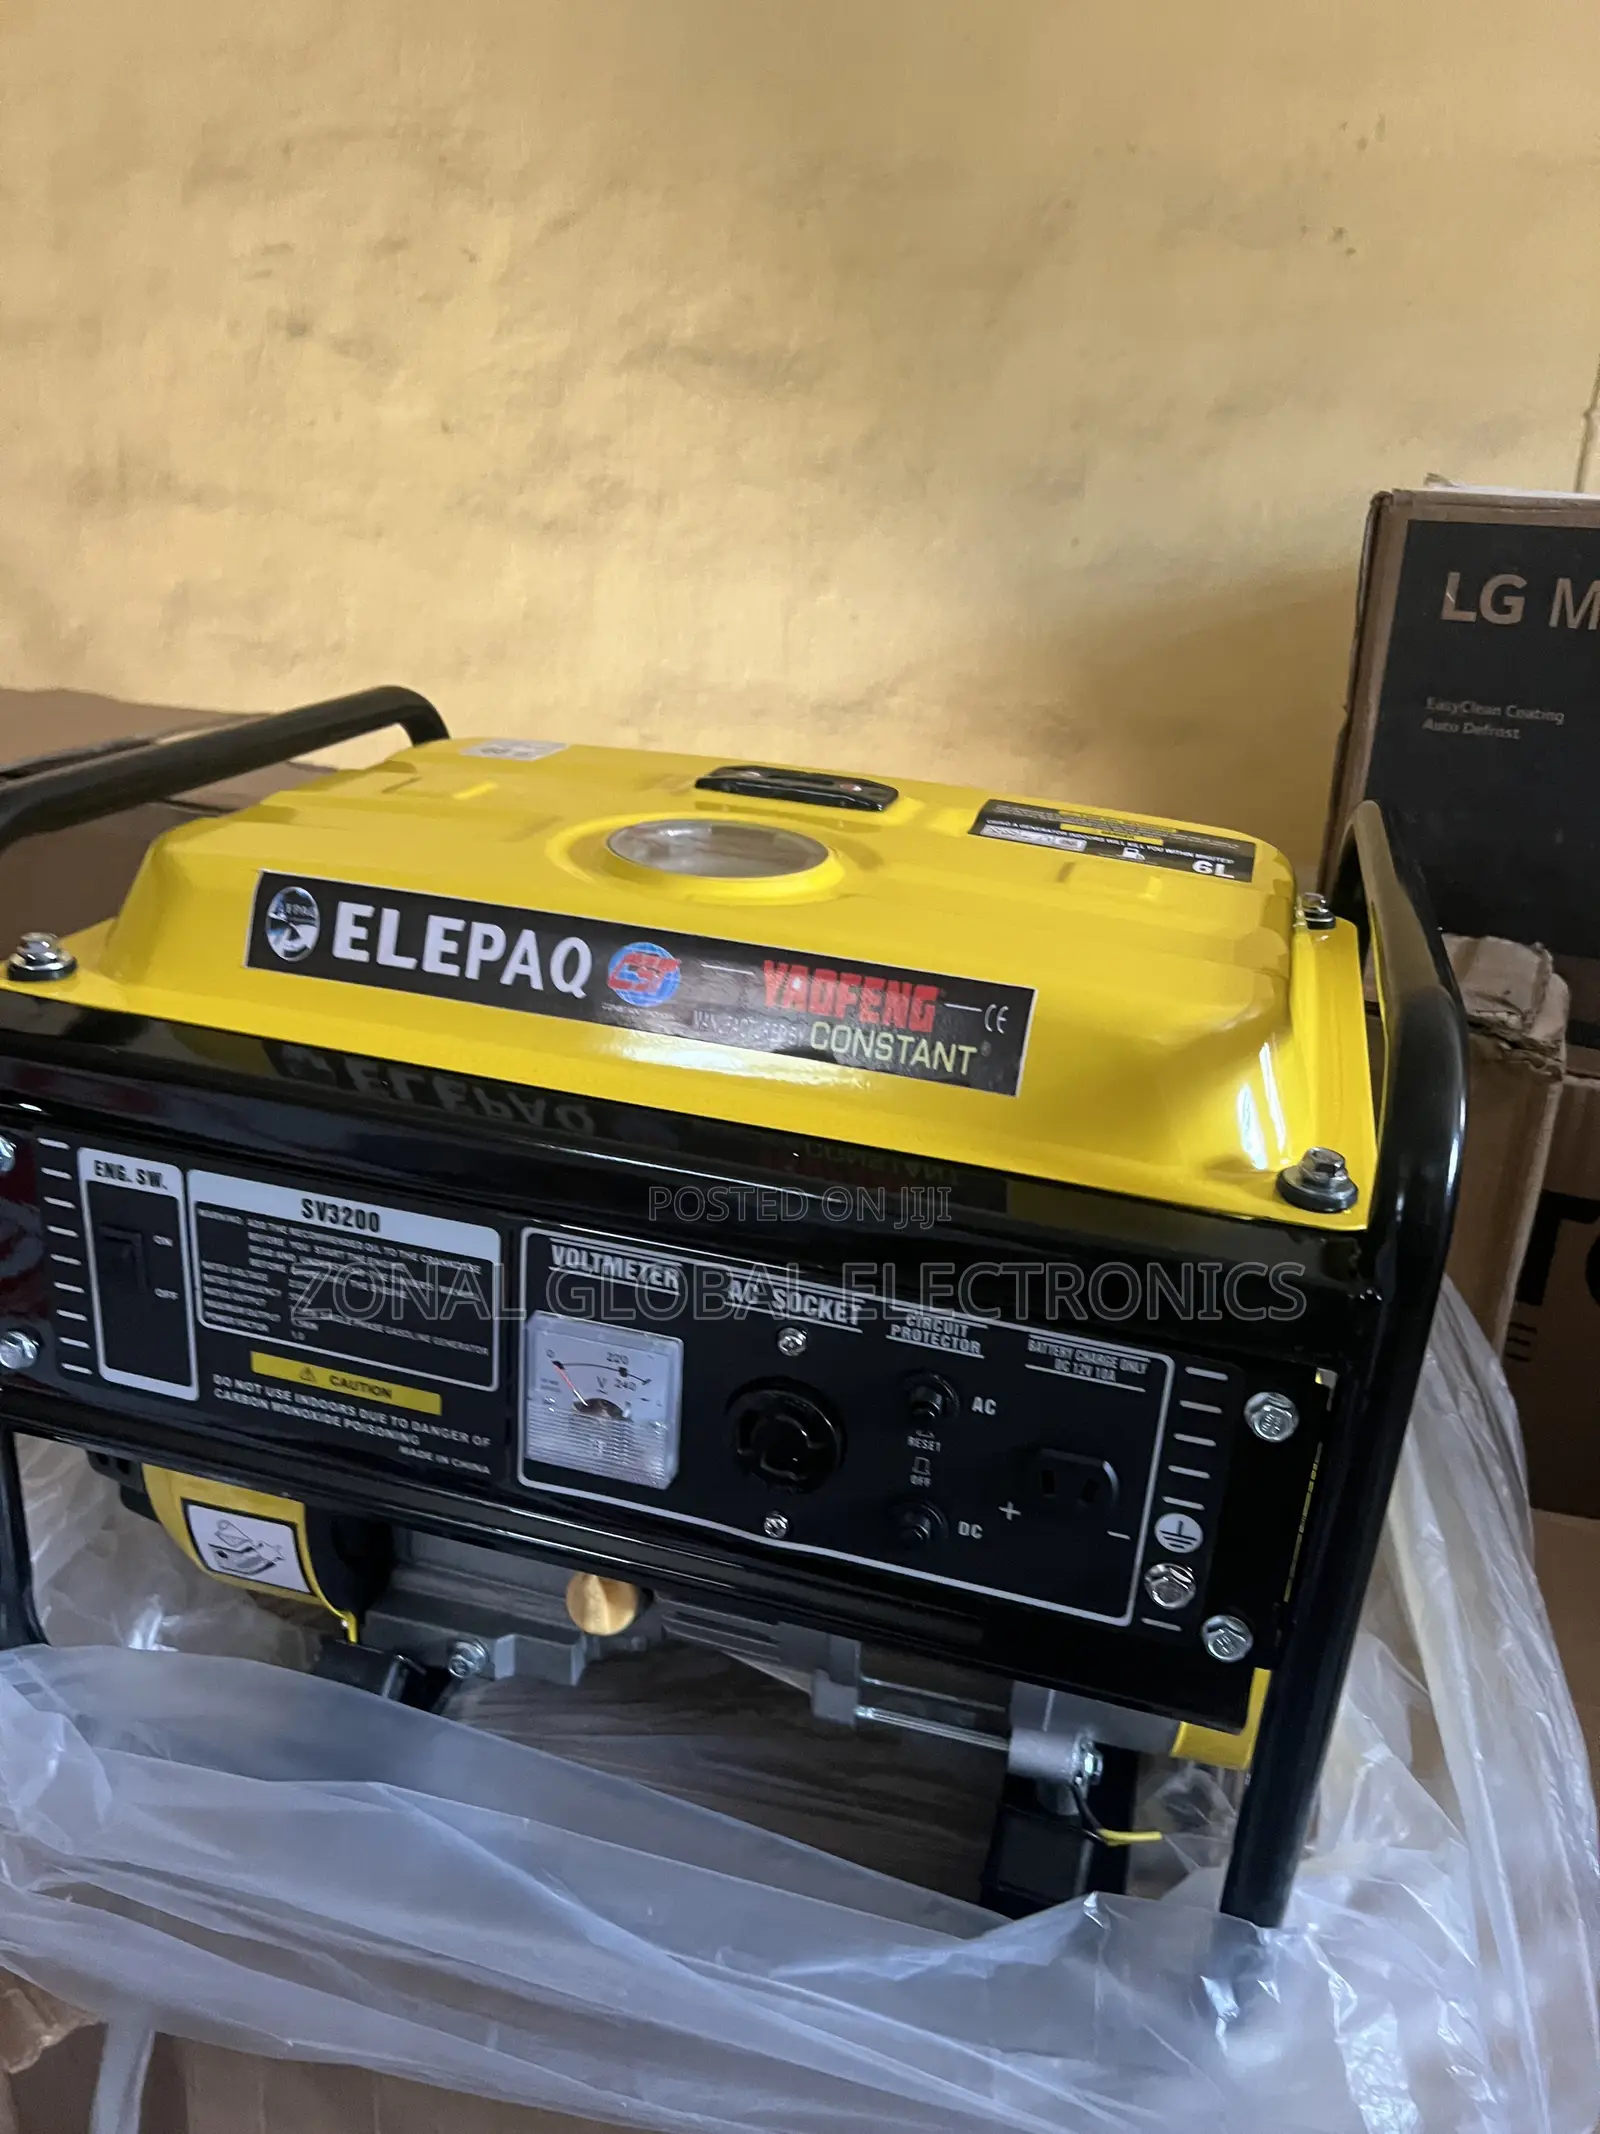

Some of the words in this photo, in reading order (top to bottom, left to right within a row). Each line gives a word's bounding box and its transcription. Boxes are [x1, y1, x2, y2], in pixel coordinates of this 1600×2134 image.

[1441, 571, 1528, 625] LG
[1425, 697, 1501, 716] EasyClean
[1422, 718, 1459, 733] Auto
[1462, 722, 1521, 740] Defrost
[1192, 860, 1235, 879] 6L
[332, 900, 593, 999] ELEPAQ
[763, 959, 940, 1033] YAOFENG
[810, 1021, 978, 1076] CONSTANT
[94, 1160, 133, 1184] ENG.
[136, 1167, 169, 1191] SW.
[301, 1198, 381, 1233] SV3200
[550, 1244, 680, 1291] VOLTMETER
[728, 1279, 759, 1304] AC
[772, 1288, 864, 1327] SOCKET
[890, 1323, 982, 1355] PROTECTOR
[905, 1311, 969, 1338] CIRCUIT
[606, 1351, 630, 1366] 220
[1027, 1339, 1073, 1360] BATTERY
[1075, 1348, 1119, 1369] CHARGE
[1119, 1357, 1149, 1375] ONLY
[1054, 1358, 1071, 1373] DC
[329, 1374, 393, 1399] CAUTION
[212, 1373, 232, 1388] DO
[234, 1378, 262, 1394] NOT
[264, 1384, 292, 1400] USE
[294, 1391, 357, 1417] INDOORS
[360, 1408, 388, 1425] DUE
[391, 1415, 408, 1429] TO
[411, 1421, 470, 1444] DANGER
[472, 1433, 491, 1447] OF
[213, 1387, 269, 1411] CARBON
[271, 1401, 342, 1428] MONOXIDE
[343, 1417, 421, 1446] POISONING
[971, 1395, 997, 1416] AC
[907, 1435, 942, 1452] RESET
[398, 1444, 435, 1463] MADE
[435, 1454, 450, 1466] IN
[451, 1457, 492, 1476] CHINA
[957, 1520, 984, 1540] DC
